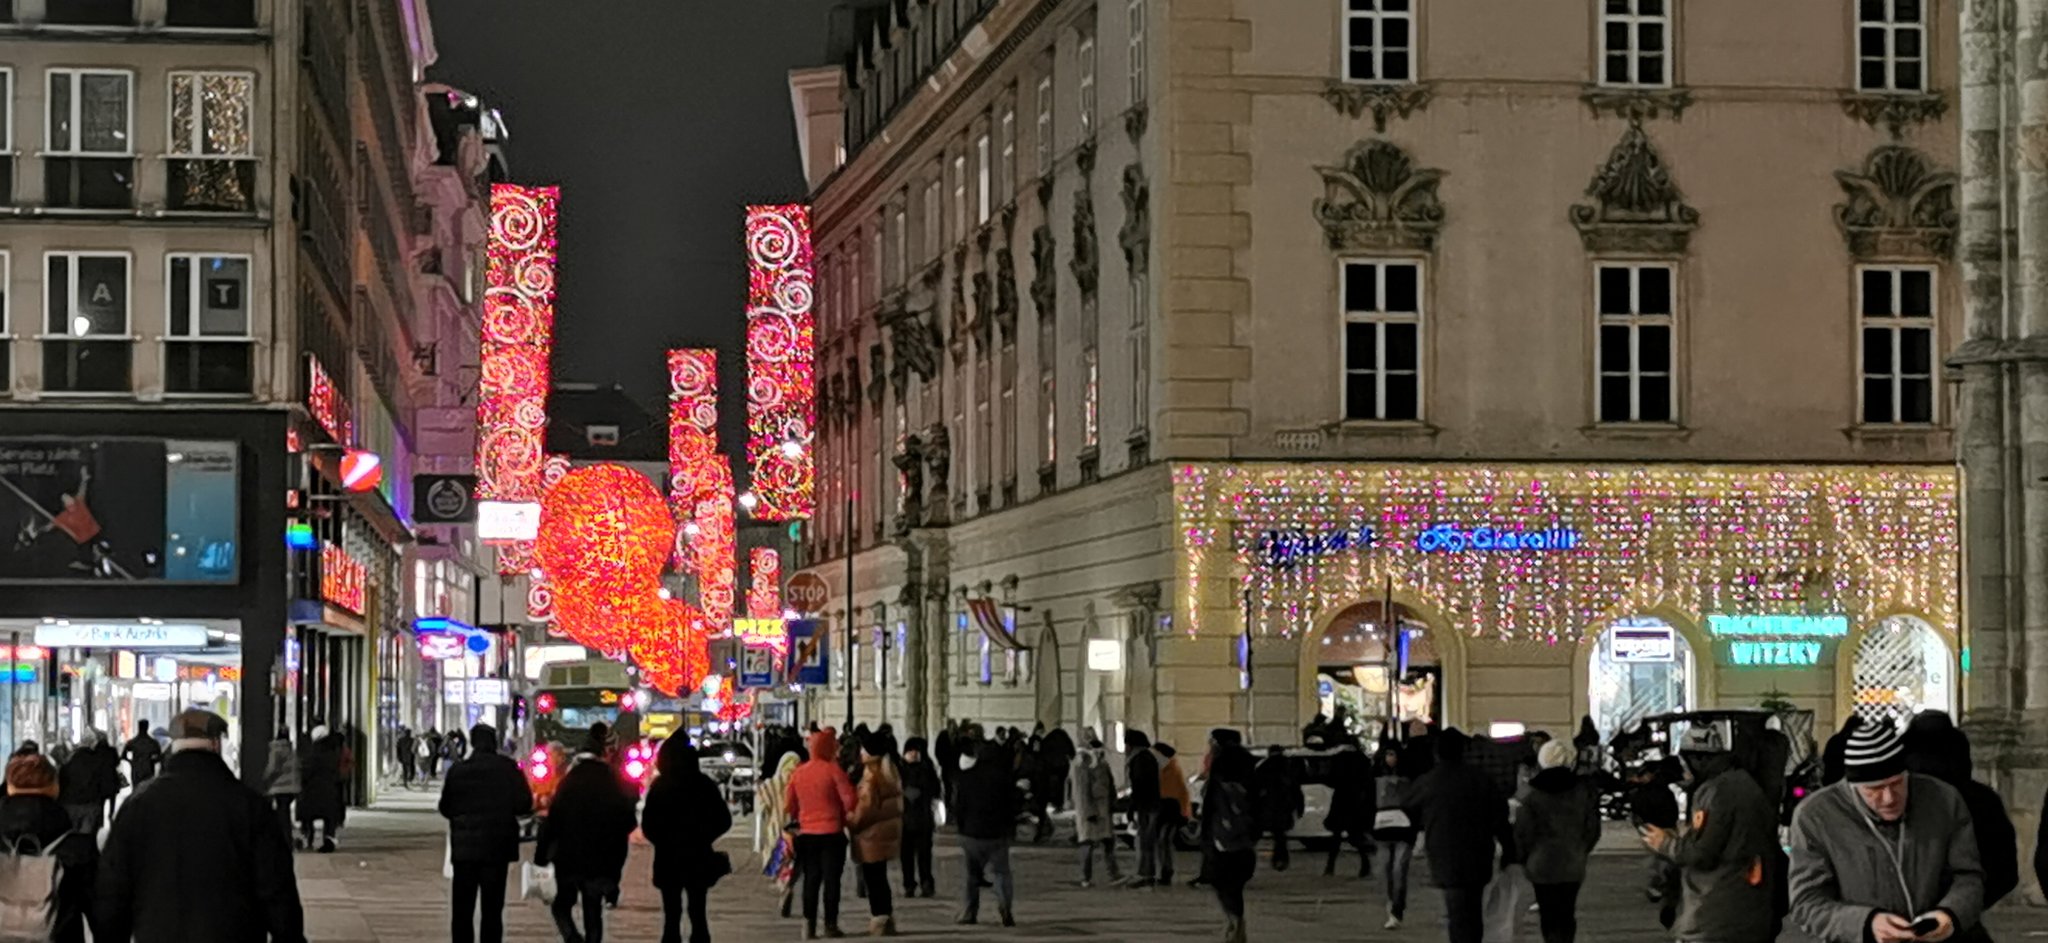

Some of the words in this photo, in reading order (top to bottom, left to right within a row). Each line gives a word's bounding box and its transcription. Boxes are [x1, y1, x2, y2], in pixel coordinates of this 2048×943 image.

[92, 283, 112, 302] A
[216, 285, 232, 304] T
[789, 586, 825, 601] STOP
[1731, 641, 1821, 664] WITZKY
